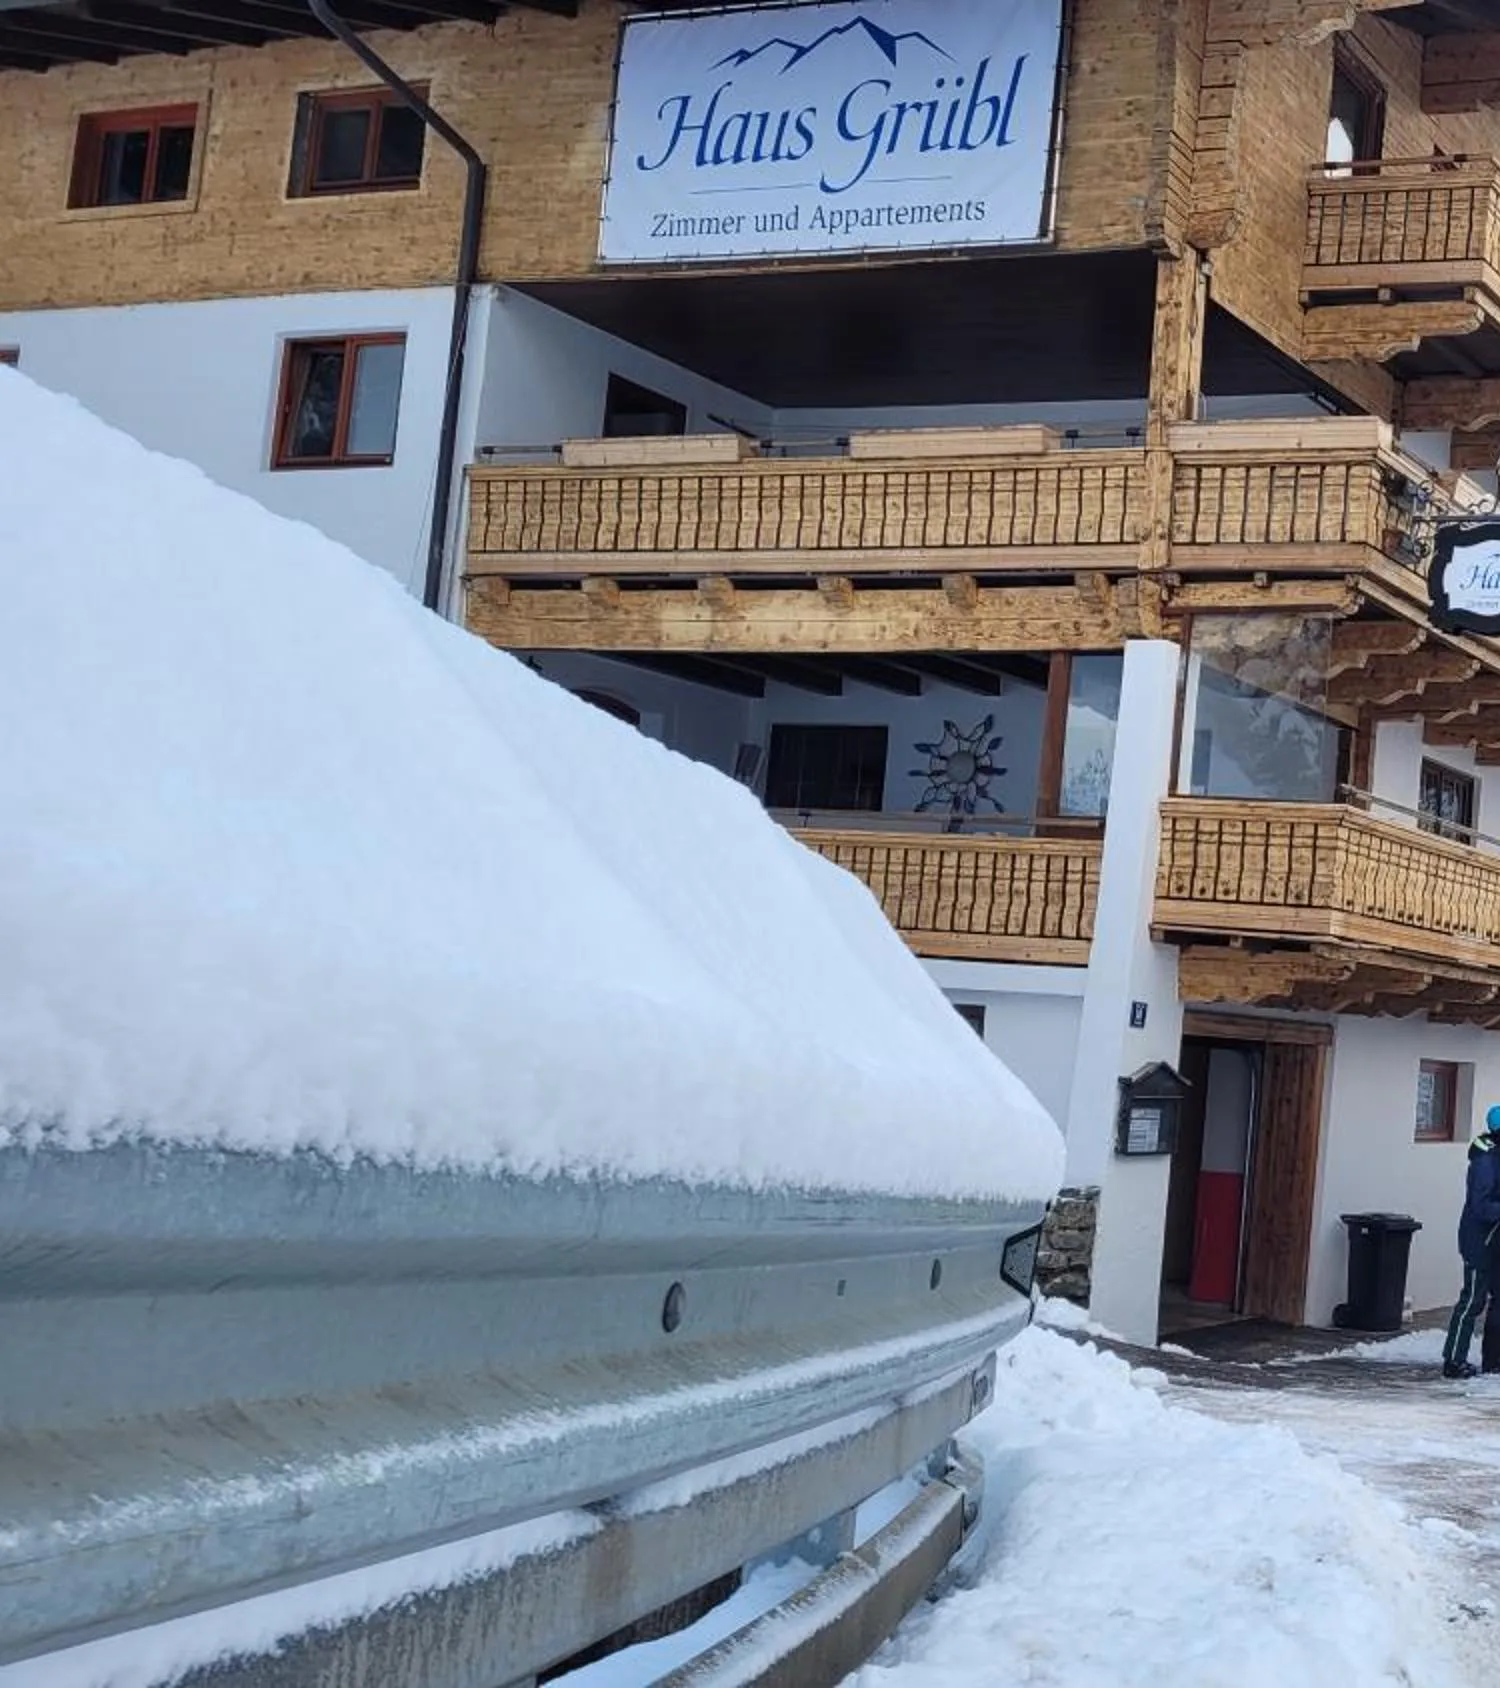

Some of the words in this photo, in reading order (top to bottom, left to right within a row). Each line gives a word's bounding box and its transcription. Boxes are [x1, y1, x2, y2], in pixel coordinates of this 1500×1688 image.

[636, 81, 817, 172] Haus
[819, 53, 1032, 193] Grübl
[650, 213, 744, 238] Zimmer
[754, 206, 800, 233] und
[808, 200, 986, 237] Appartements
